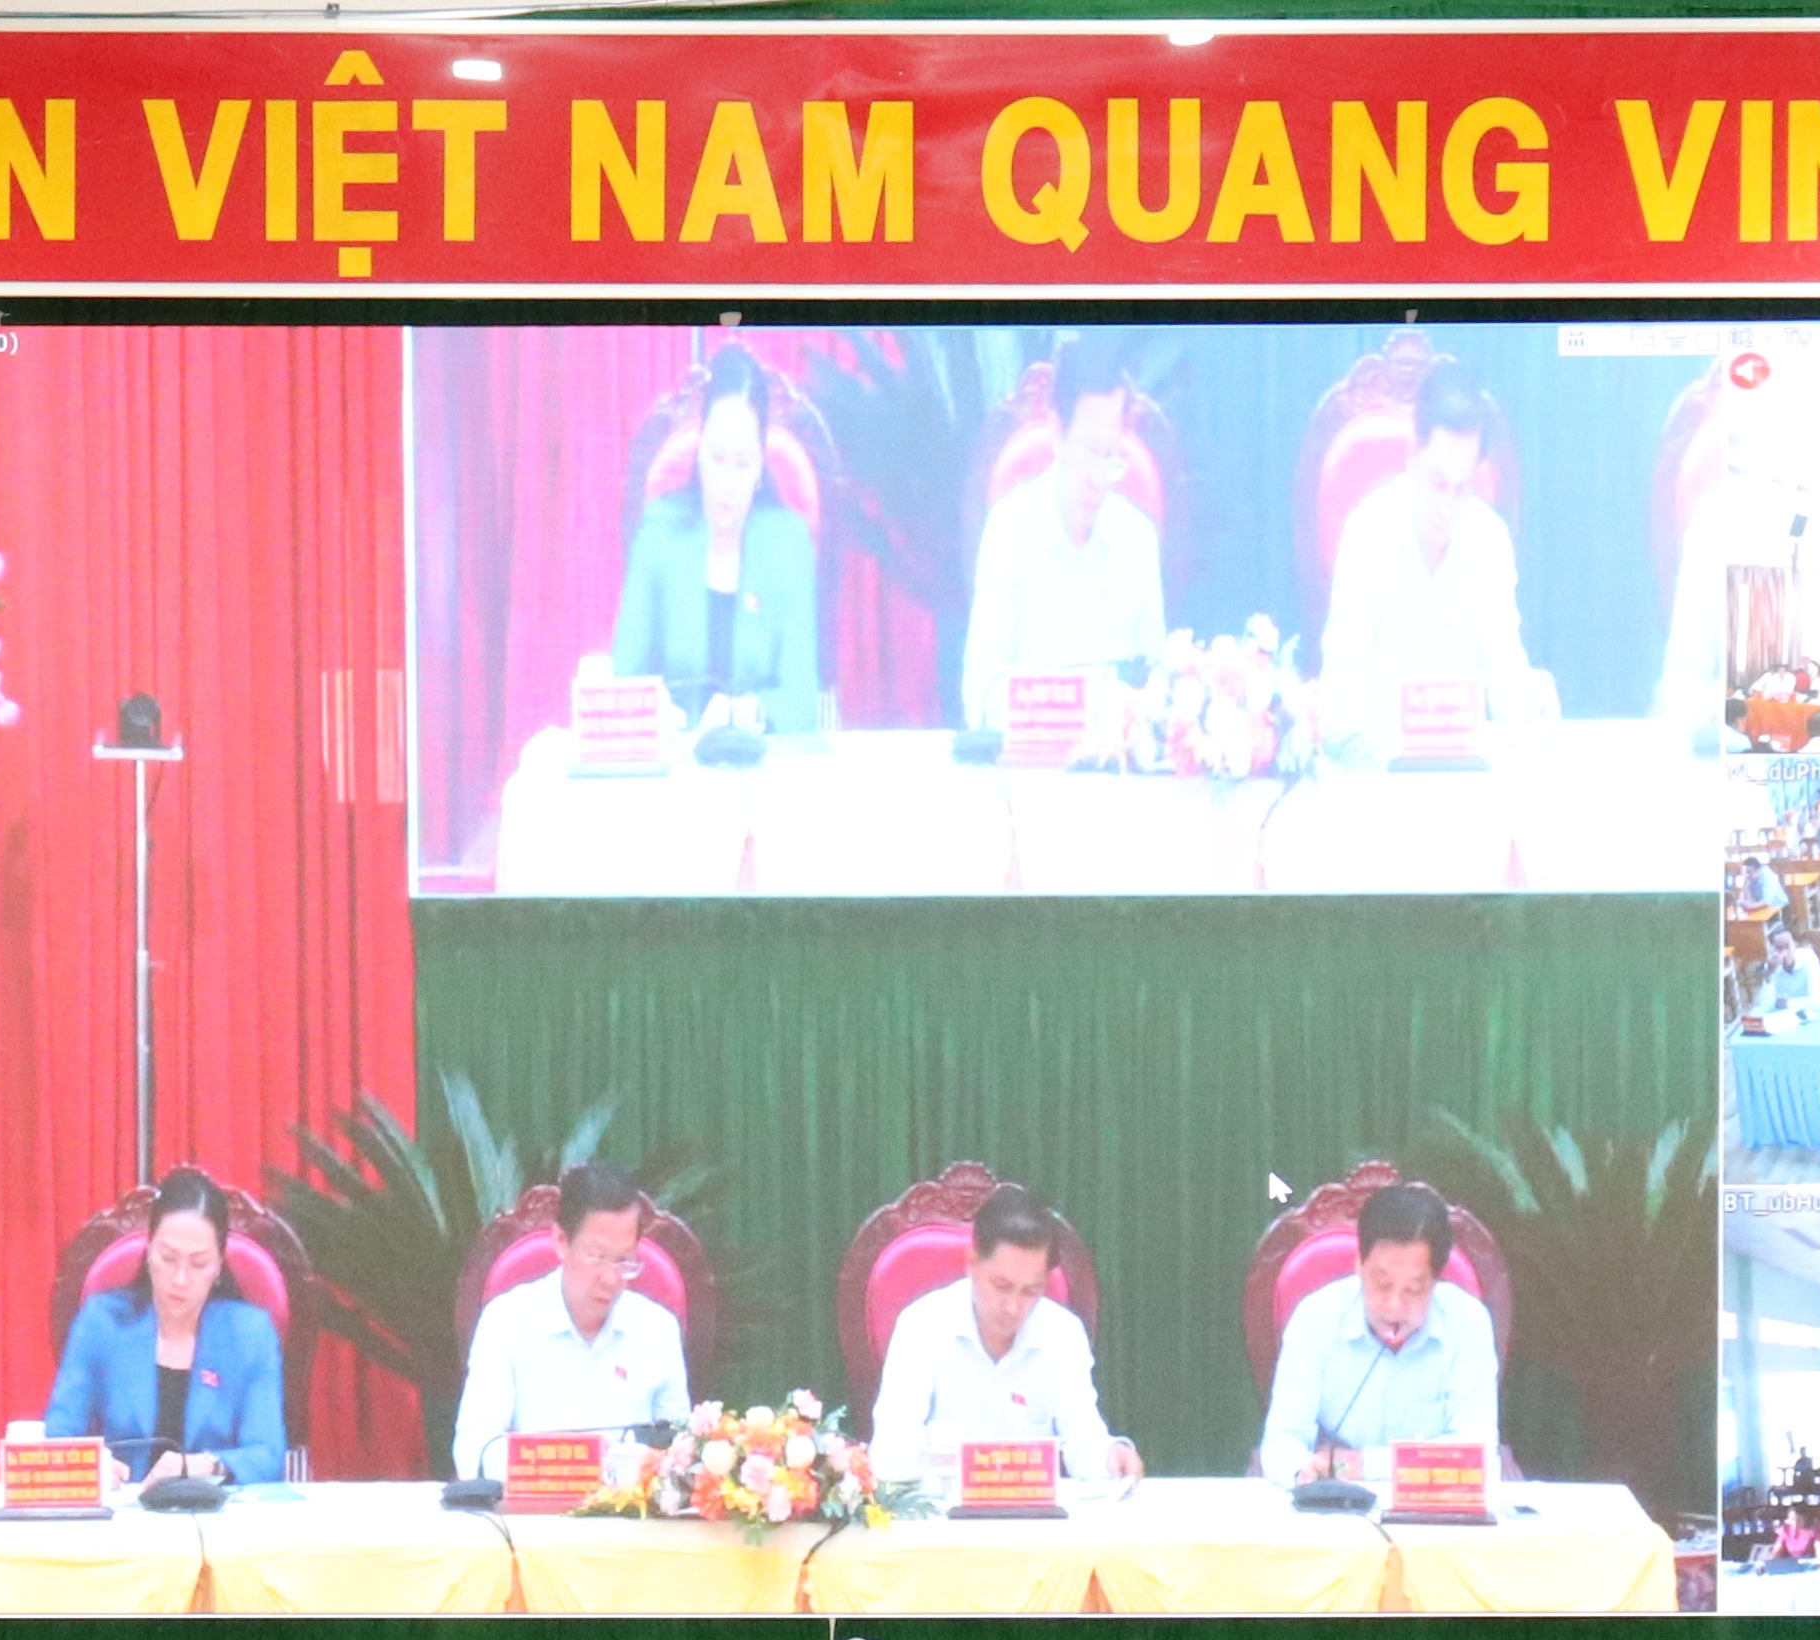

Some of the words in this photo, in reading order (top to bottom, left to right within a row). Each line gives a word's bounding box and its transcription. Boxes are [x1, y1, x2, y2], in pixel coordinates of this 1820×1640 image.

[142, 49, 509, 278] VIỆT
[570, 99, 916, 243] NAM
[980, 96, 1551, 252] QUANG
